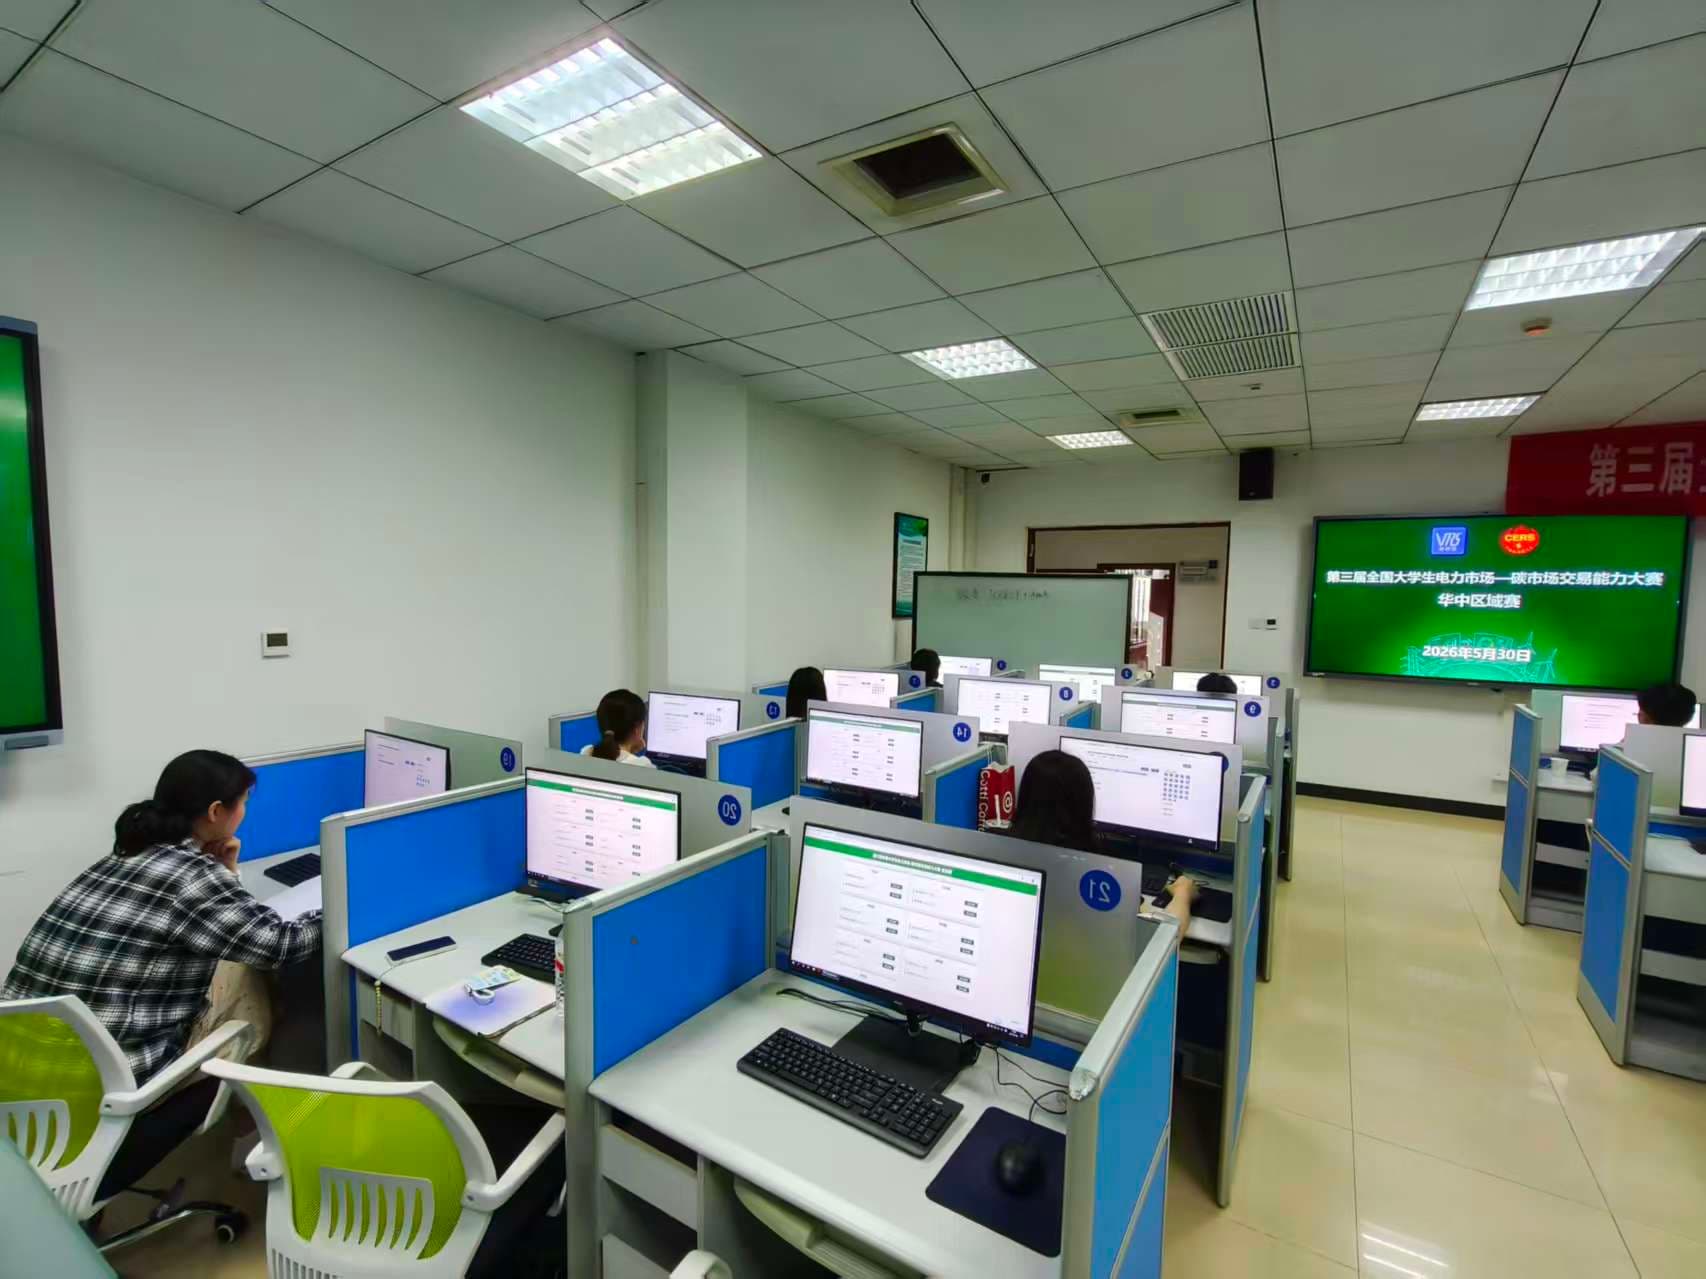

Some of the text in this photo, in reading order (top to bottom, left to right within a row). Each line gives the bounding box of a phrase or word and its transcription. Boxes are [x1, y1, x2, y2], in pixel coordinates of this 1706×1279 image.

[1586, 442, 1706, 497] 第三届
[1504, 533, 1536, 542] CERS
[1437, 593, 1521, 609] 华中区域赛
[1422, 645, 1532, 662] 2026年5月30日
